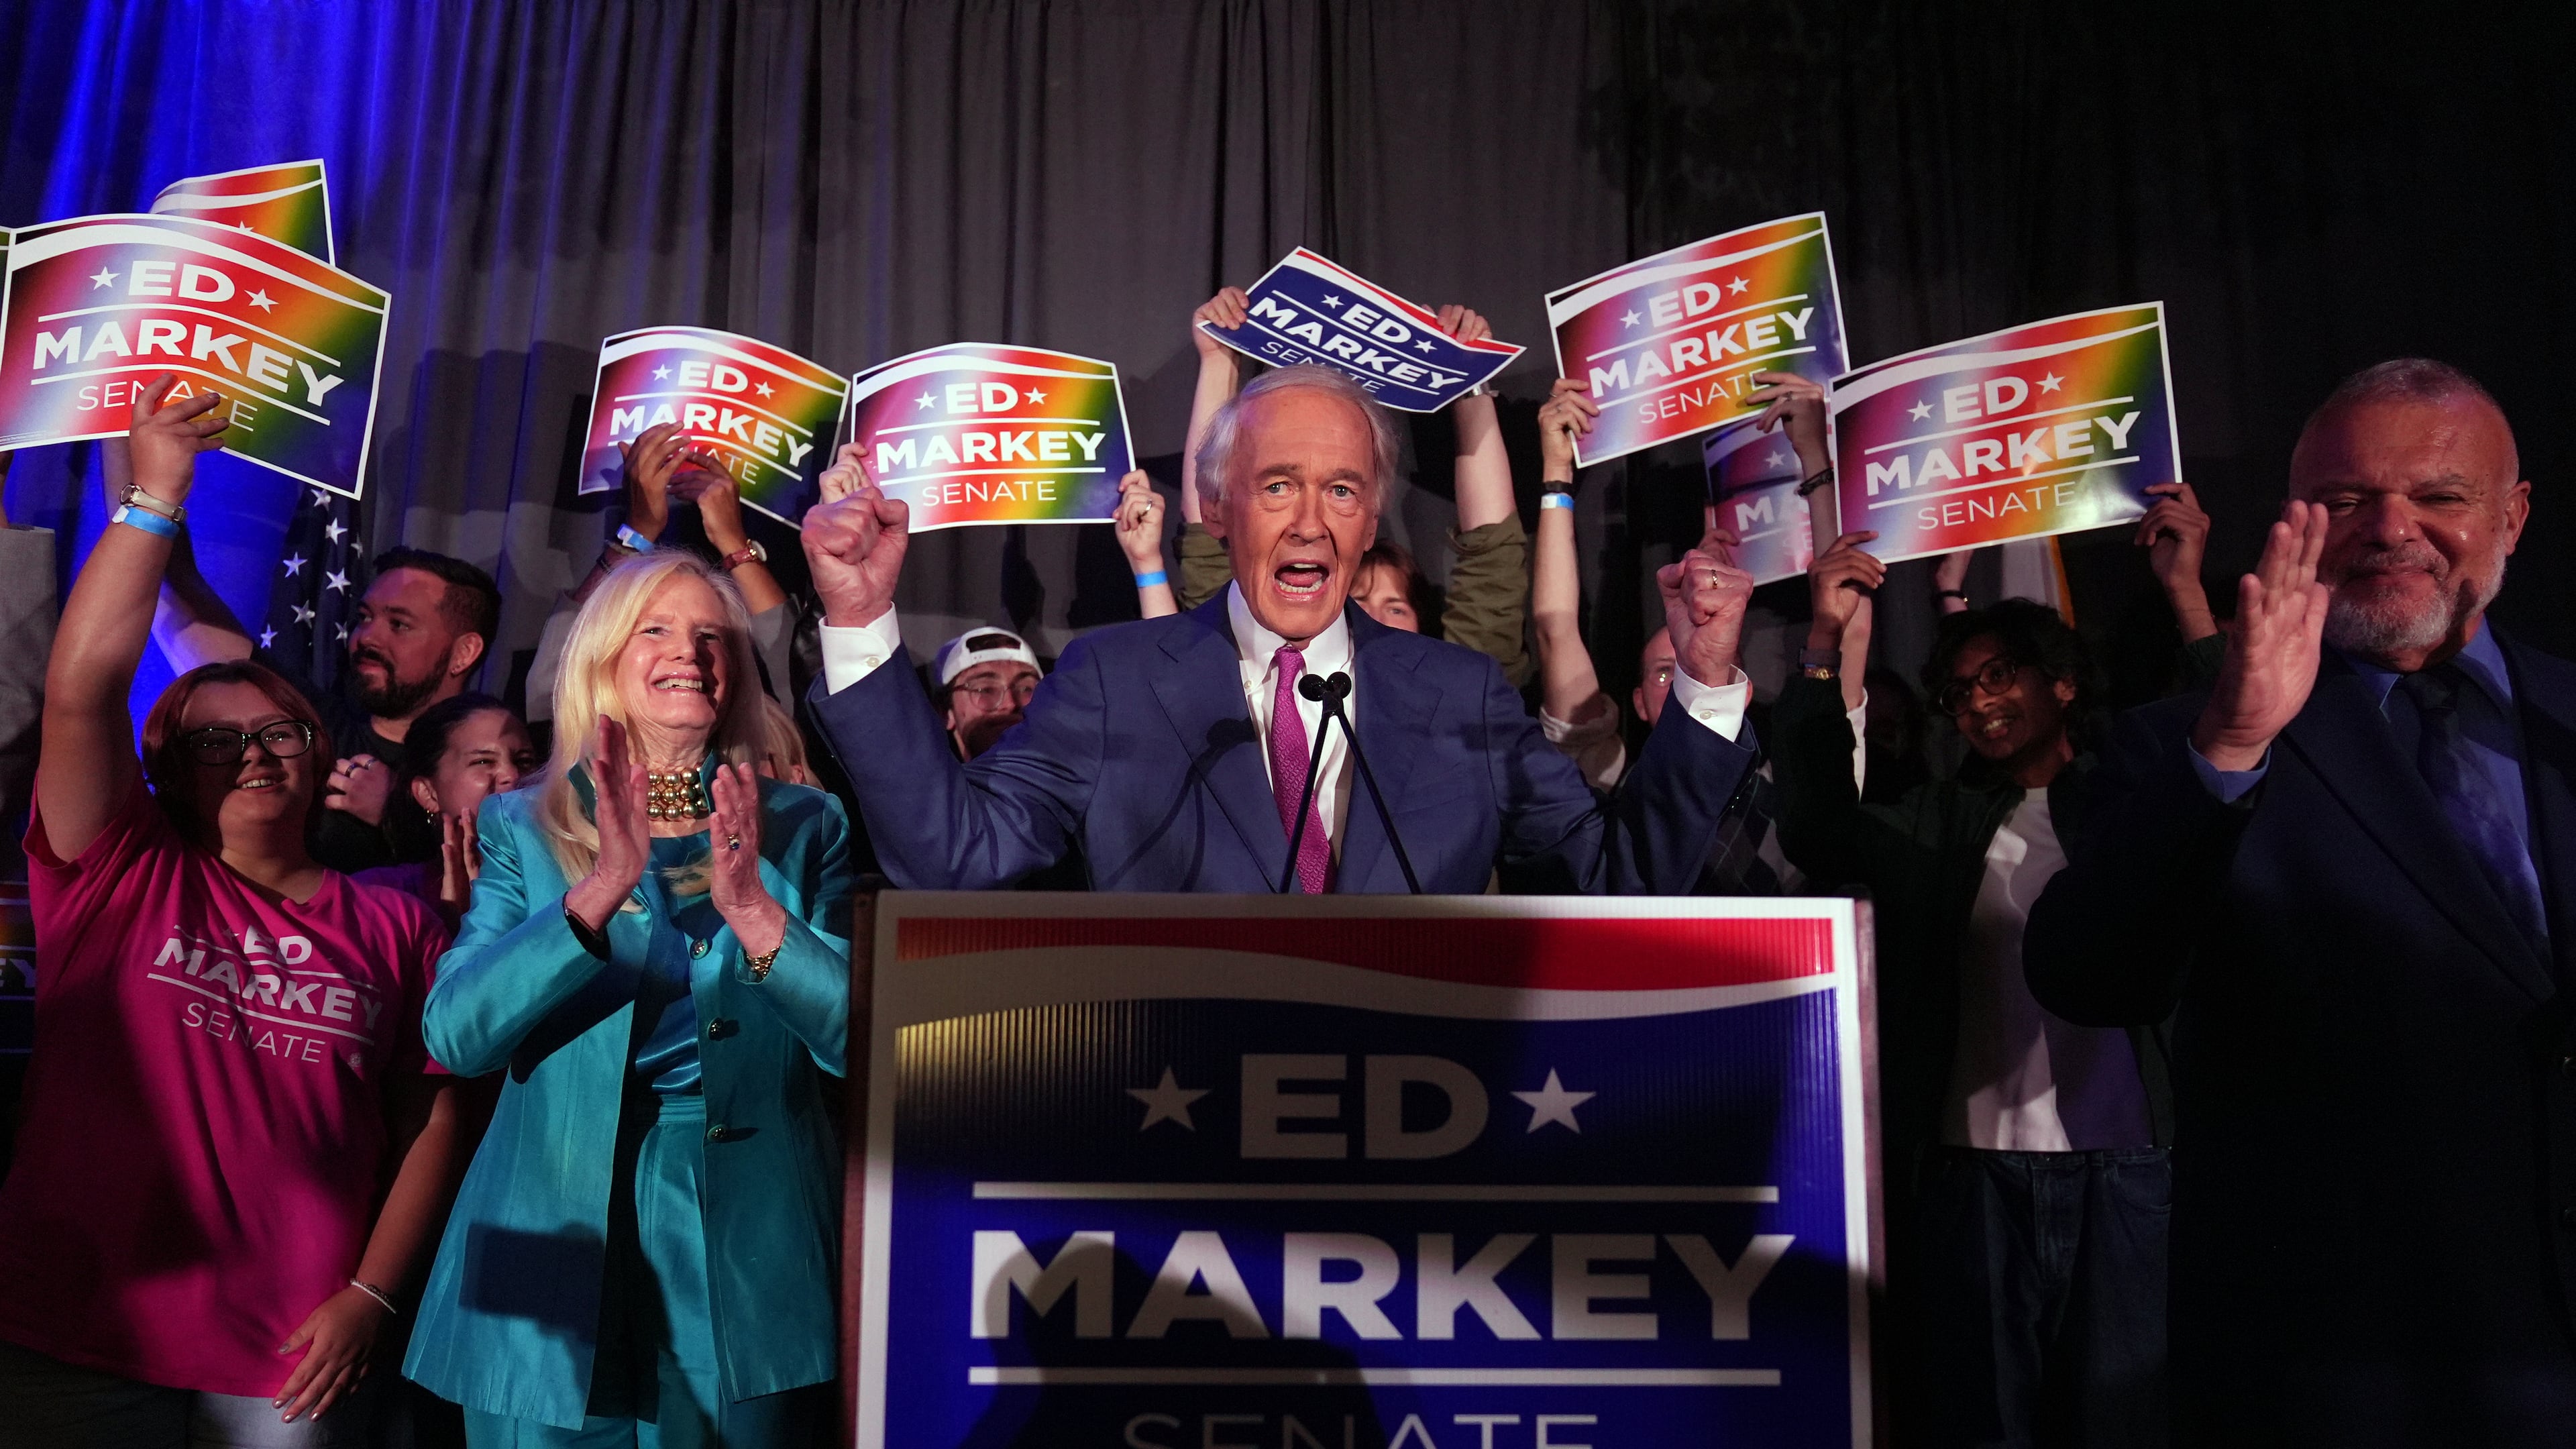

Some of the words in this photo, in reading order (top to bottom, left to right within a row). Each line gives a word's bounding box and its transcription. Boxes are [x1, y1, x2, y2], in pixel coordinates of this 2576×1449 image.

[128, 260, 235, 303] ED
[1648, 282, 1721, 328] ED
[1249, 297, 1465, 389] MARKEY
[1341, 303, 1411, 345] ED
[33, 319, 344, 407] MARKEY
[678, 360, 748, 392] ED
[1260, 341, 1386, 393] SETE
[1589, 307, 1814, 398] MARKEY
[945, 382, 1019, 414] ED
[1639, 368, 1769, 424] SENATE
[1943, 376, 2029, 424] ED
[610, 402, 814, 467] MARKEY
[876, 431, 1106, 474] MARKEY
[1866, 411, 2140, 496] MARKEY
[922, 480, 1057, 506] SENATE
[1917, 481, 2077, 530] SENATE
[244, 924, 313, 965] ED
[153, 937, 382, 1030] MARKEY
[182, 1002, 326, 1063] SENATE
[1239, 1053, 1490, 1160] ED
[970, 1230, 1796, 1340] MARKEY
